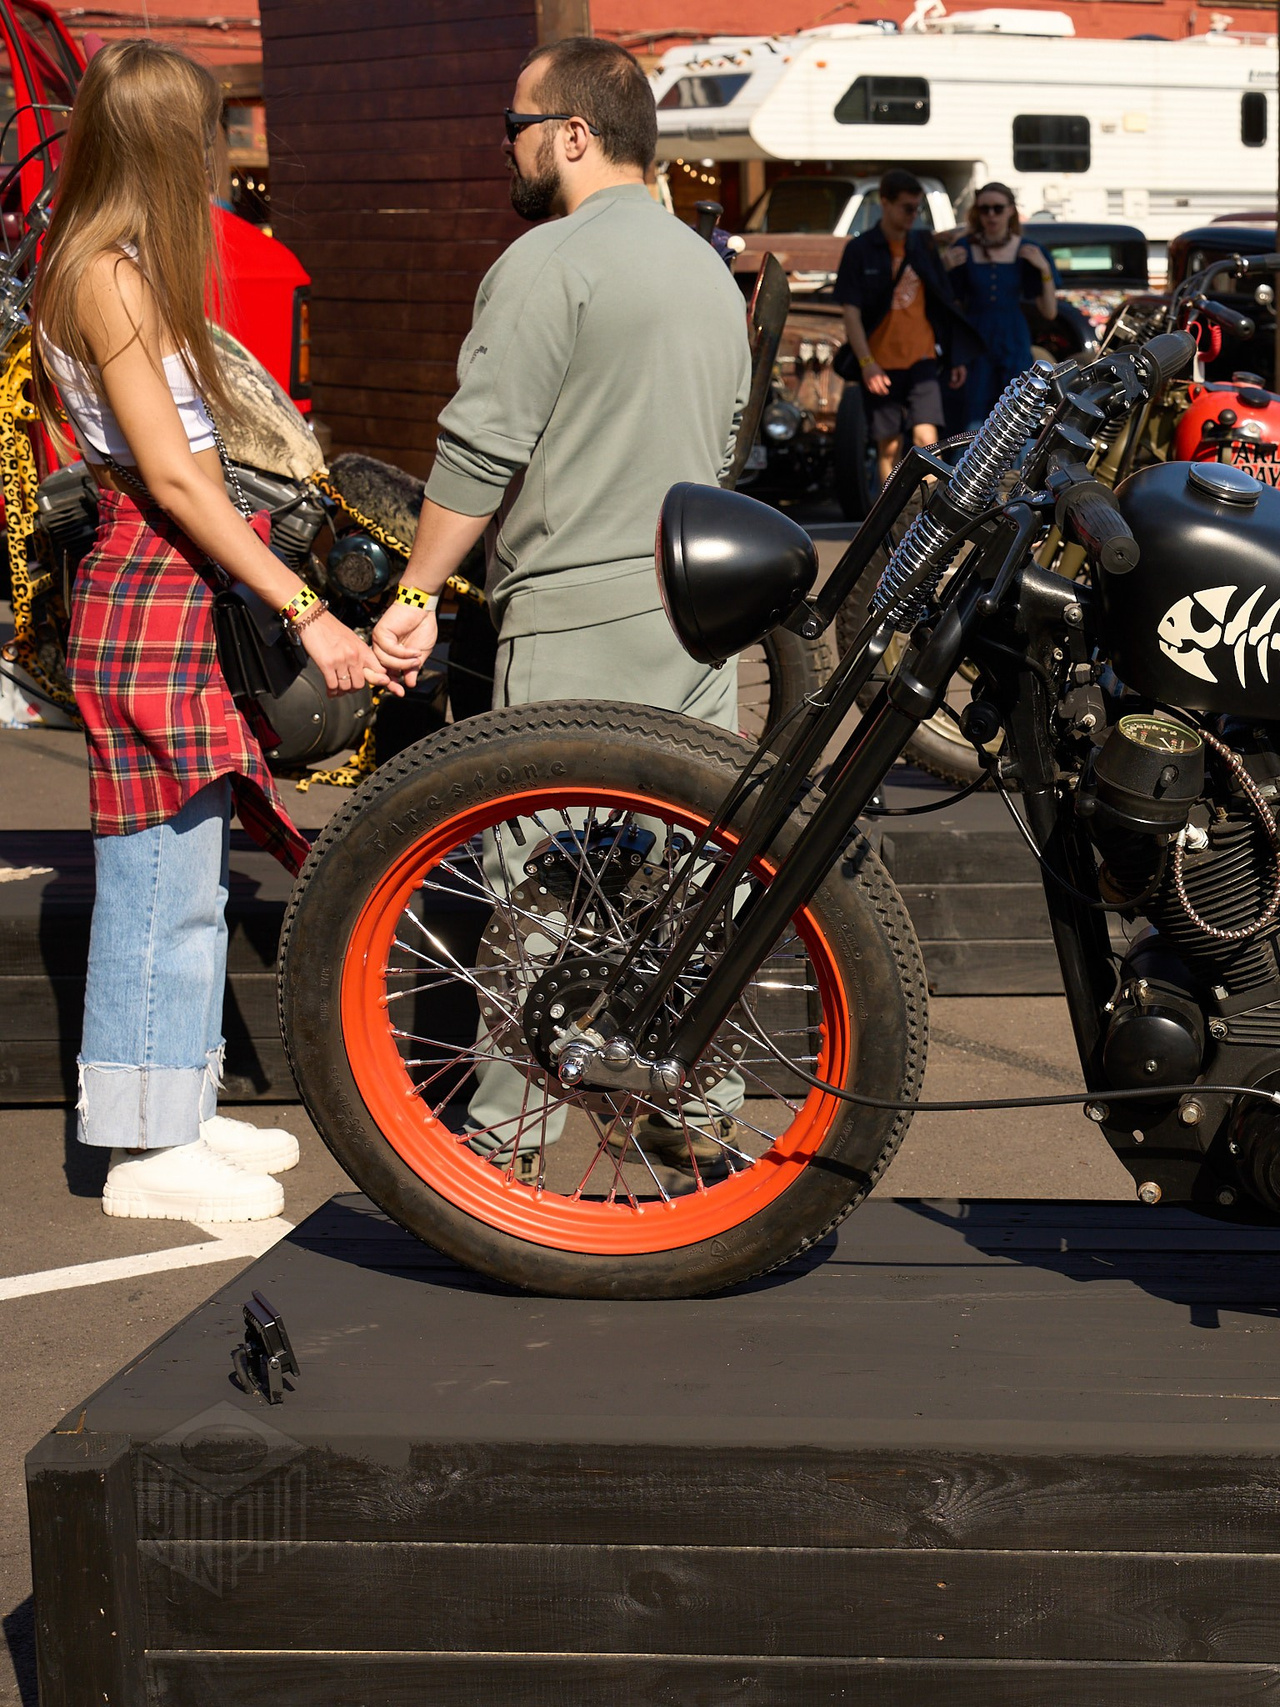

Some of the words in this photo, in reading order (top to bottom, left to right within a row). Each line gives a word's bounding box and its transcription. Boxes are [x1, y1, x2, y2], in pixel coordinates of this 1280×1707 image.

[365, 760, 567, 855] Firestone
[410, 805, 457, 838] DELUXE
[466, 780, 538, 806] CHAMPION
